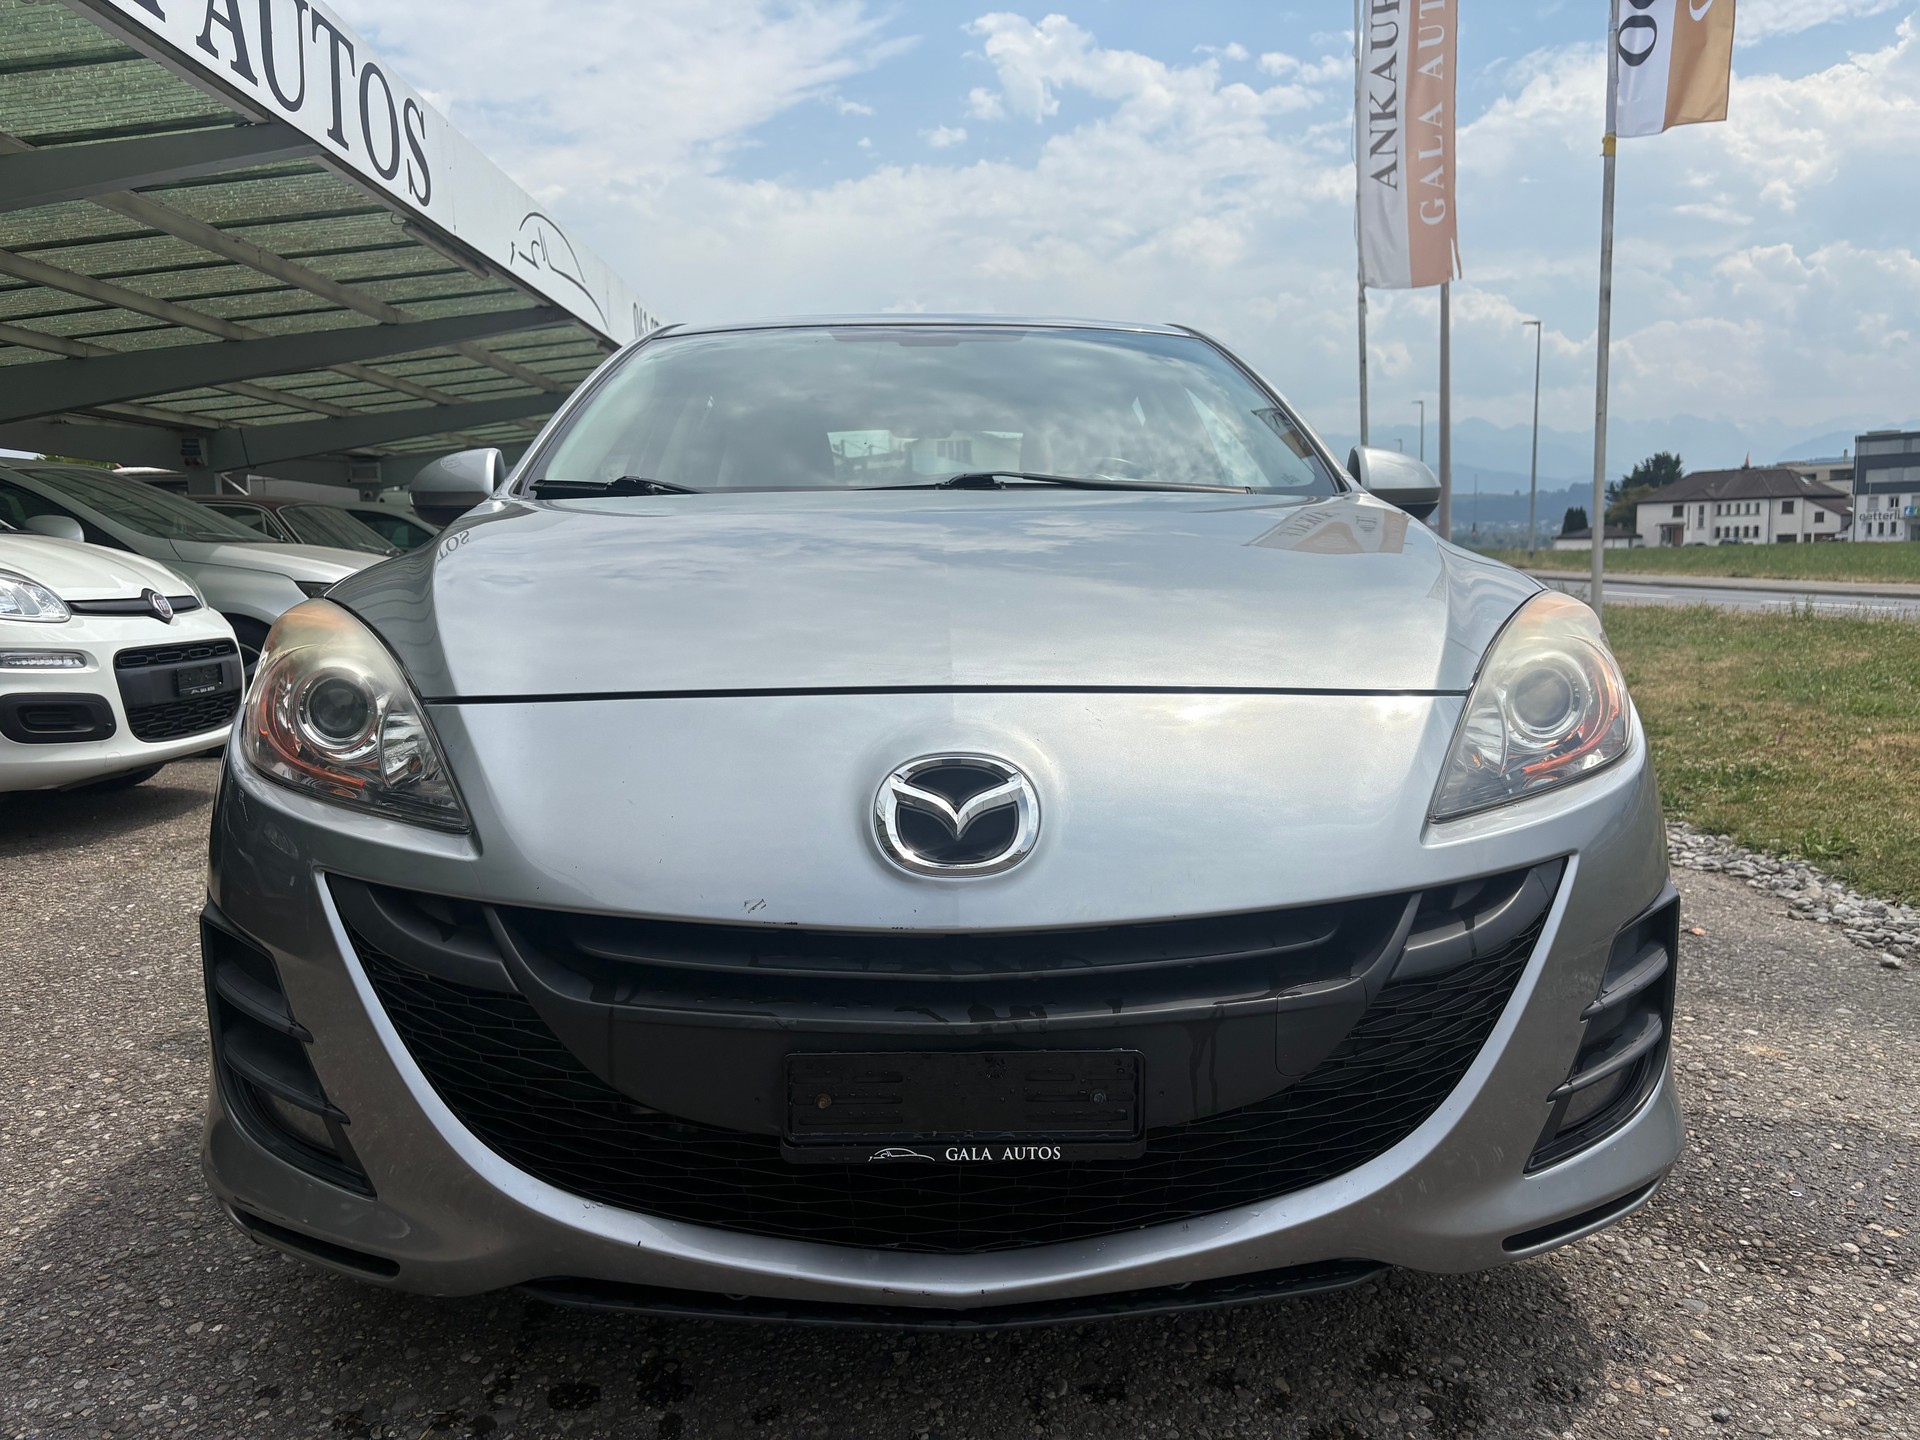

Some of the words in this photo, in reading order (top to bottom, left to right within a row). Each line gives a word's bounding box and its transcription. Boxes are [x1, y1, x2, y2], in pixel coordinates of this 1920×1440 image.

[1417, 101, 1446, 226] GALA
[945, 1147, 993, 1161] GALA
[1002, 1146, 1061, 1161] AUTOS
